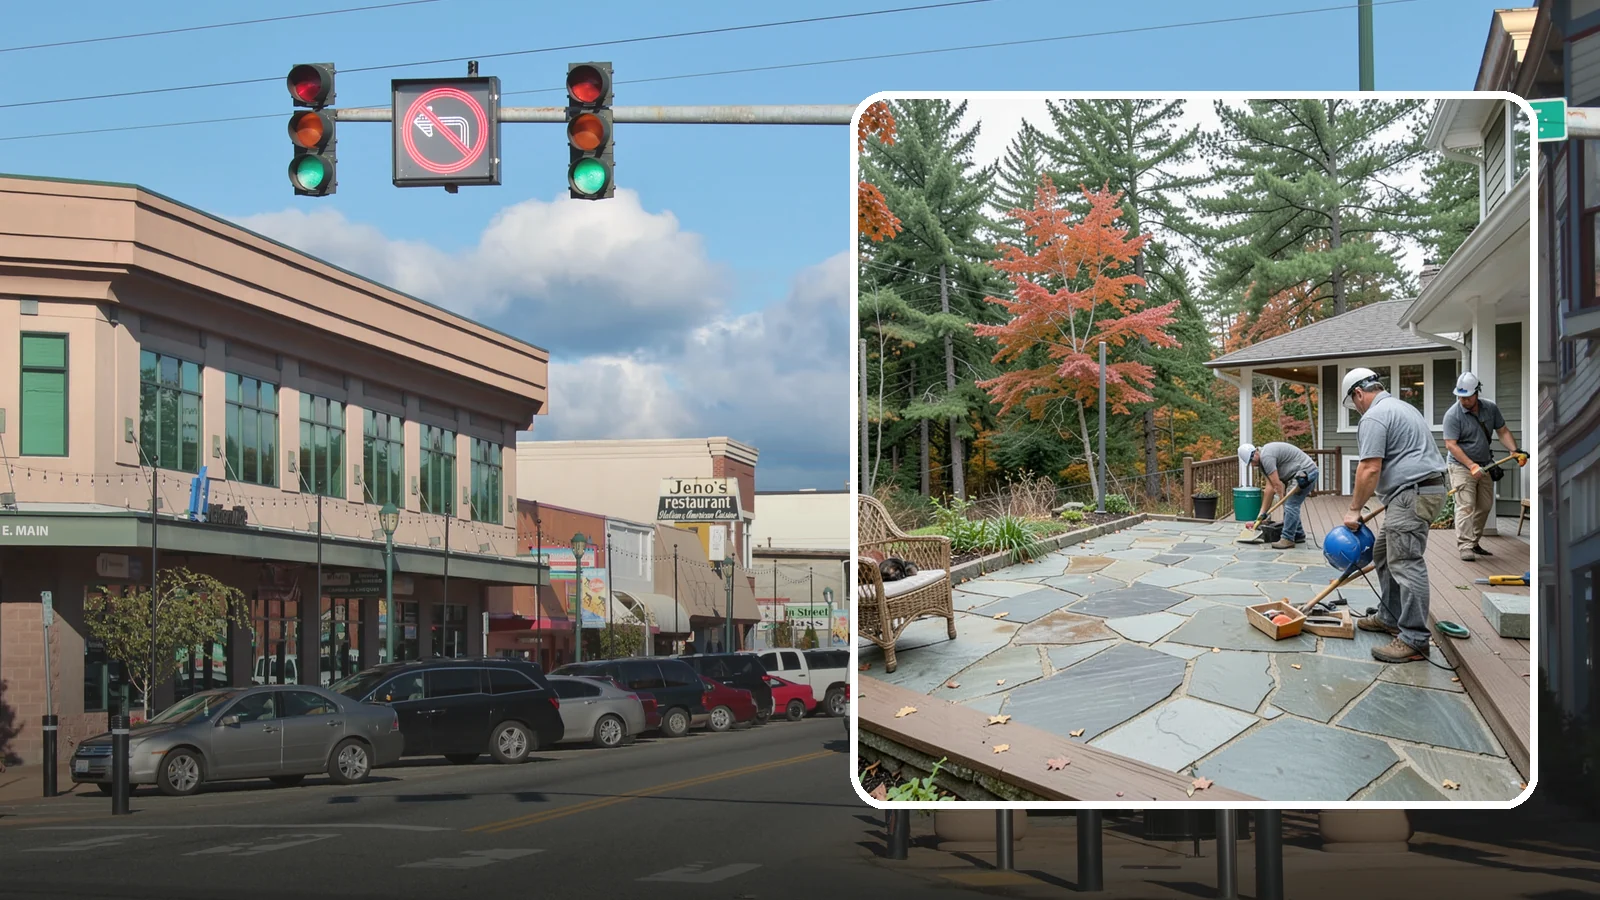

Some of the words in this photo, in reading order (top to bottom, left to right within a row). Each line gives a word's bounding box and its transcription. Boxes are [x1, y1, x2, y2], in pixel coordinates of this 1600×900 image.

[669, 480, 727, 494] Jeno's
[665, 497, 731, 509] restaurant
[659, 510, 681, 519] Italian
[686, 510, 714, 519] American
[715, 510, 737, 519] Cuisine
[2, 525, 13, 536] E.
[15, 525, 49, 536] MAIN
[797, 607, 828, 617] Street
